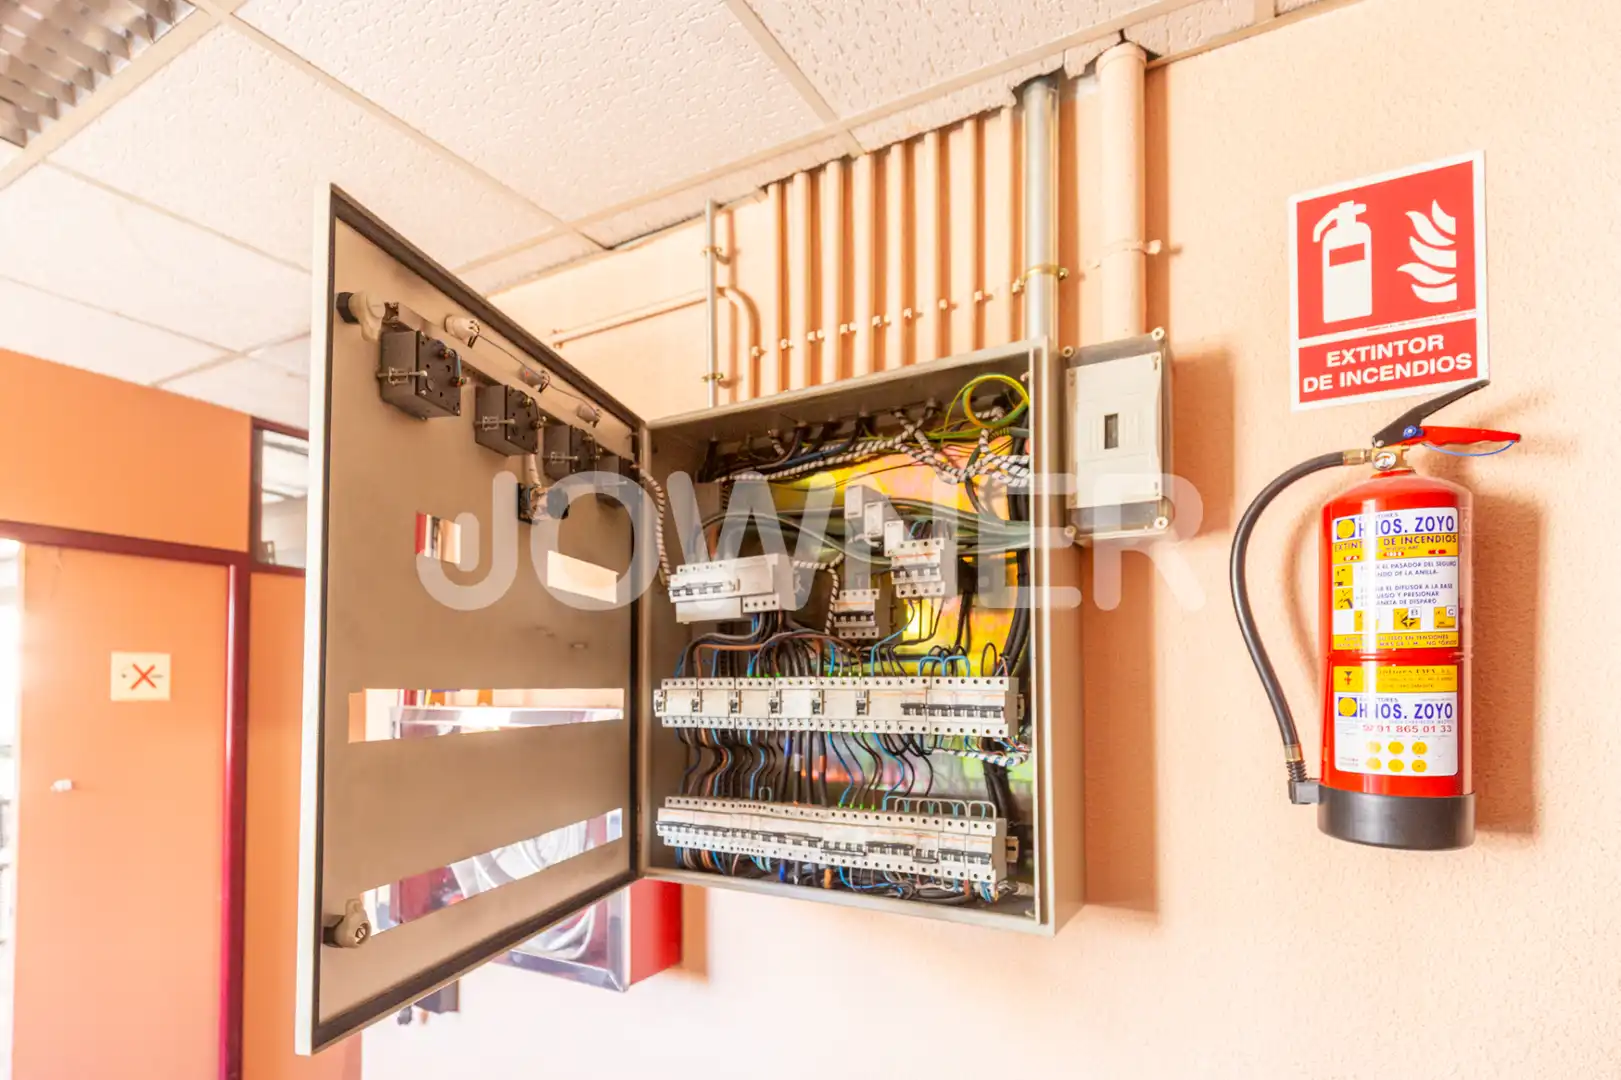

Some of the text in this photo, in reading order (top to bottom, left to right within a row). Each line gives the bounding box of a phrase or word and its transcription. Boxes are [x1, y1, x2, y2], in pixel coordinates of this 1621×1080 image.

[1326, 334, 1444, 368] EXTINTOR
[1303, 353, 1472, 393] DE INCENDIOS
[1359, 516, 1454, 537] HOS. ZOYO
[1384, 538, 1396, 546] DE
[1401, 535, 1457, 545] INCENDIOS
[1391, 561, 1421, 569] PASADOR
[1414, 703, 1453, 719] ZOYO
[1377, 723, 1452, 733] 91 865 01 33
